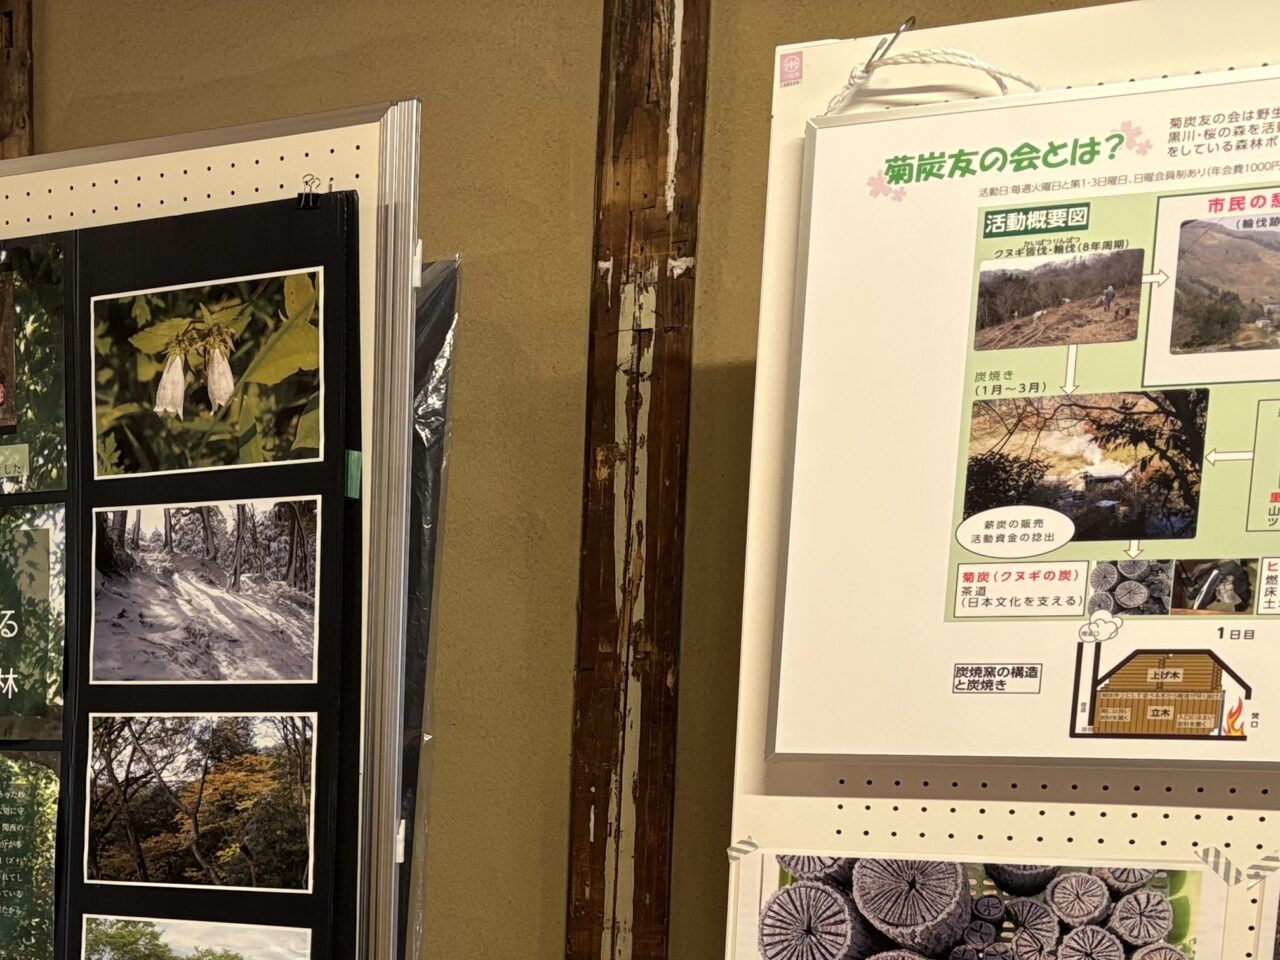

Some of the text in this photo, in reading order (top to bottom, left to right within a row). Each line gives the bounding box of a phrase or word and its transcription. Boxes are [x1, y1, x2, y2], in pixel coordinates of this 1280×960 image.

[1168, 121, 1280, 143] 黒川・桜の森を活
[986, 207, 1088, 233] 活動概要図
[974, 369, 1014, 382] 炭焼き
[984, 519, 1044, 530] 薪炭の販売
[961, 586, 987, 597] 茶道
[955, 666, 1038, 678] 炭焼窯の構造
[955, 679, 1007, 691] と炭焼き
[1151, 709, 1170, 717] 立木
